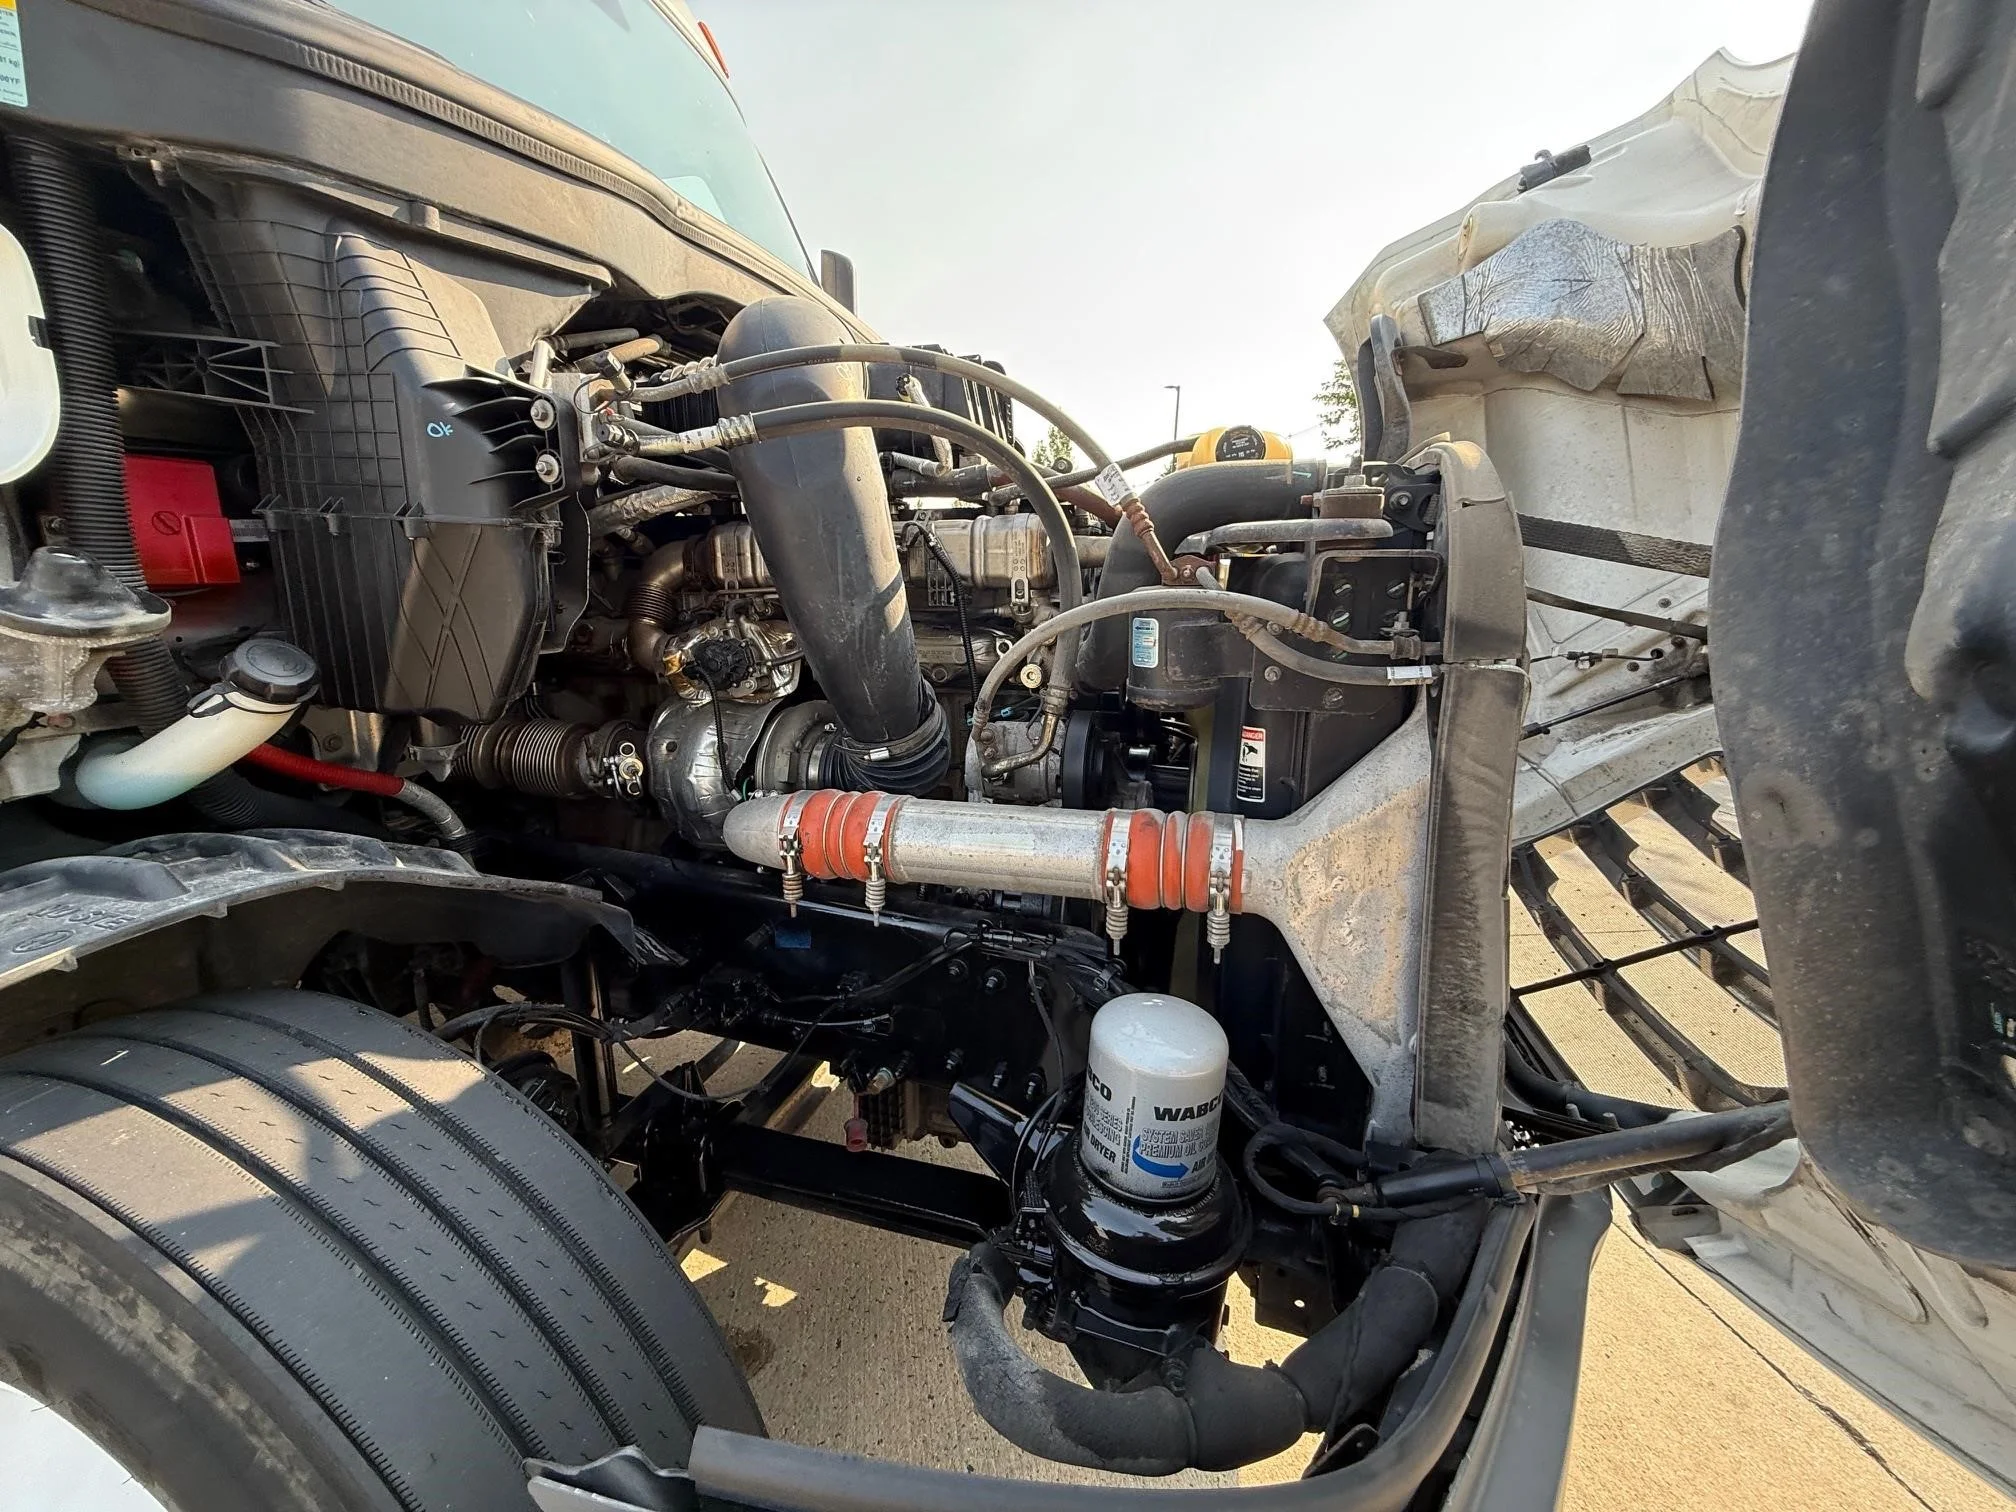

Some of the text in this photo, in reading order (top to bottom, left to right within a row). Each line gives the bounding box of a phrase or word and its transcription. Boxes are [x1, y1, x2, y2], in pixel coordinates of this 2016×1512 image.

[1142, 1127, 1178, 1145] SYSTEM
[1090, 1134, 1117, 1164] DRYER
[1140, 1142, 1183, 1159] PREMIUM
[1184, 1141, 1197, 1157] OIL
[1191, 1156, 1207, 1174] AIR
